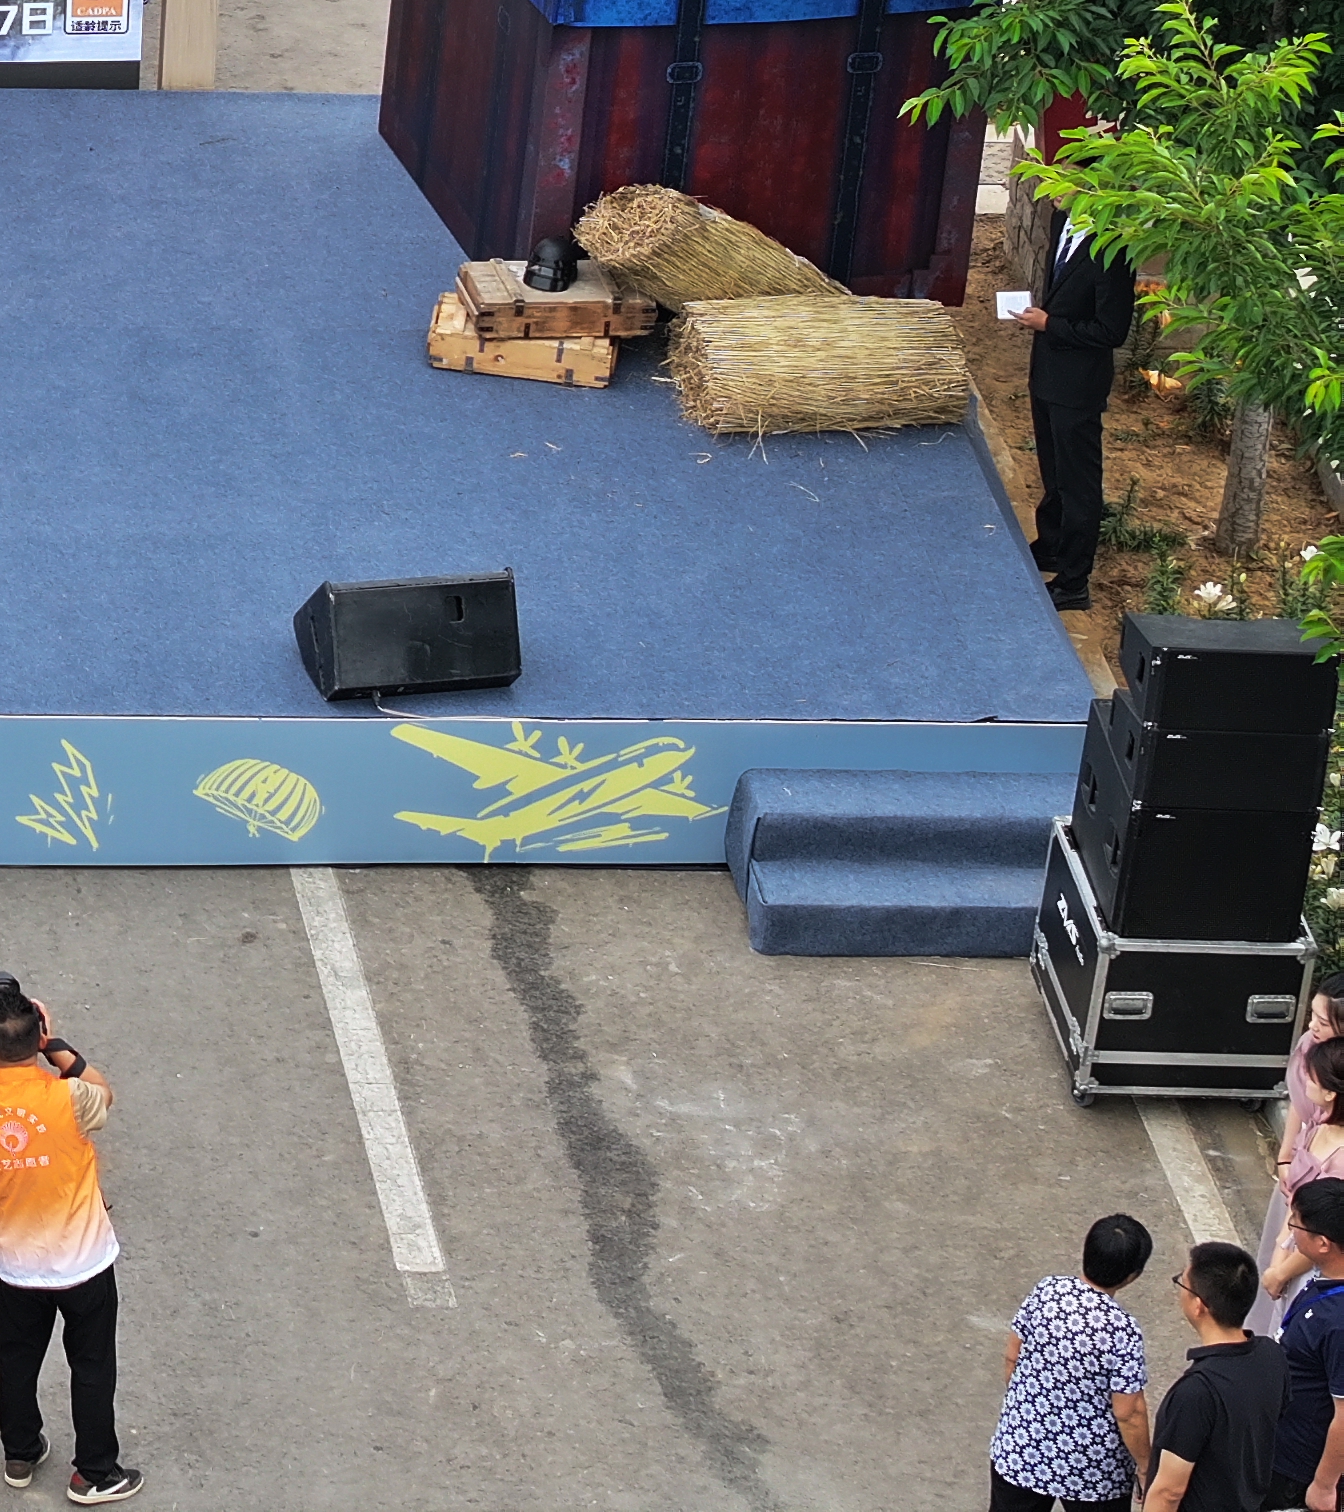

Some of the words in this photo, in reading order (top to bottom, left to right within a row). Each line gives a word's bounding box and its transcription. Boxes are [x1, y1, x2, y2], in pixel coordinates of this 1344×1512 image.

[76, 7, 117, 16] CADPA
[71, 20, 122, 32] 适龄提示
